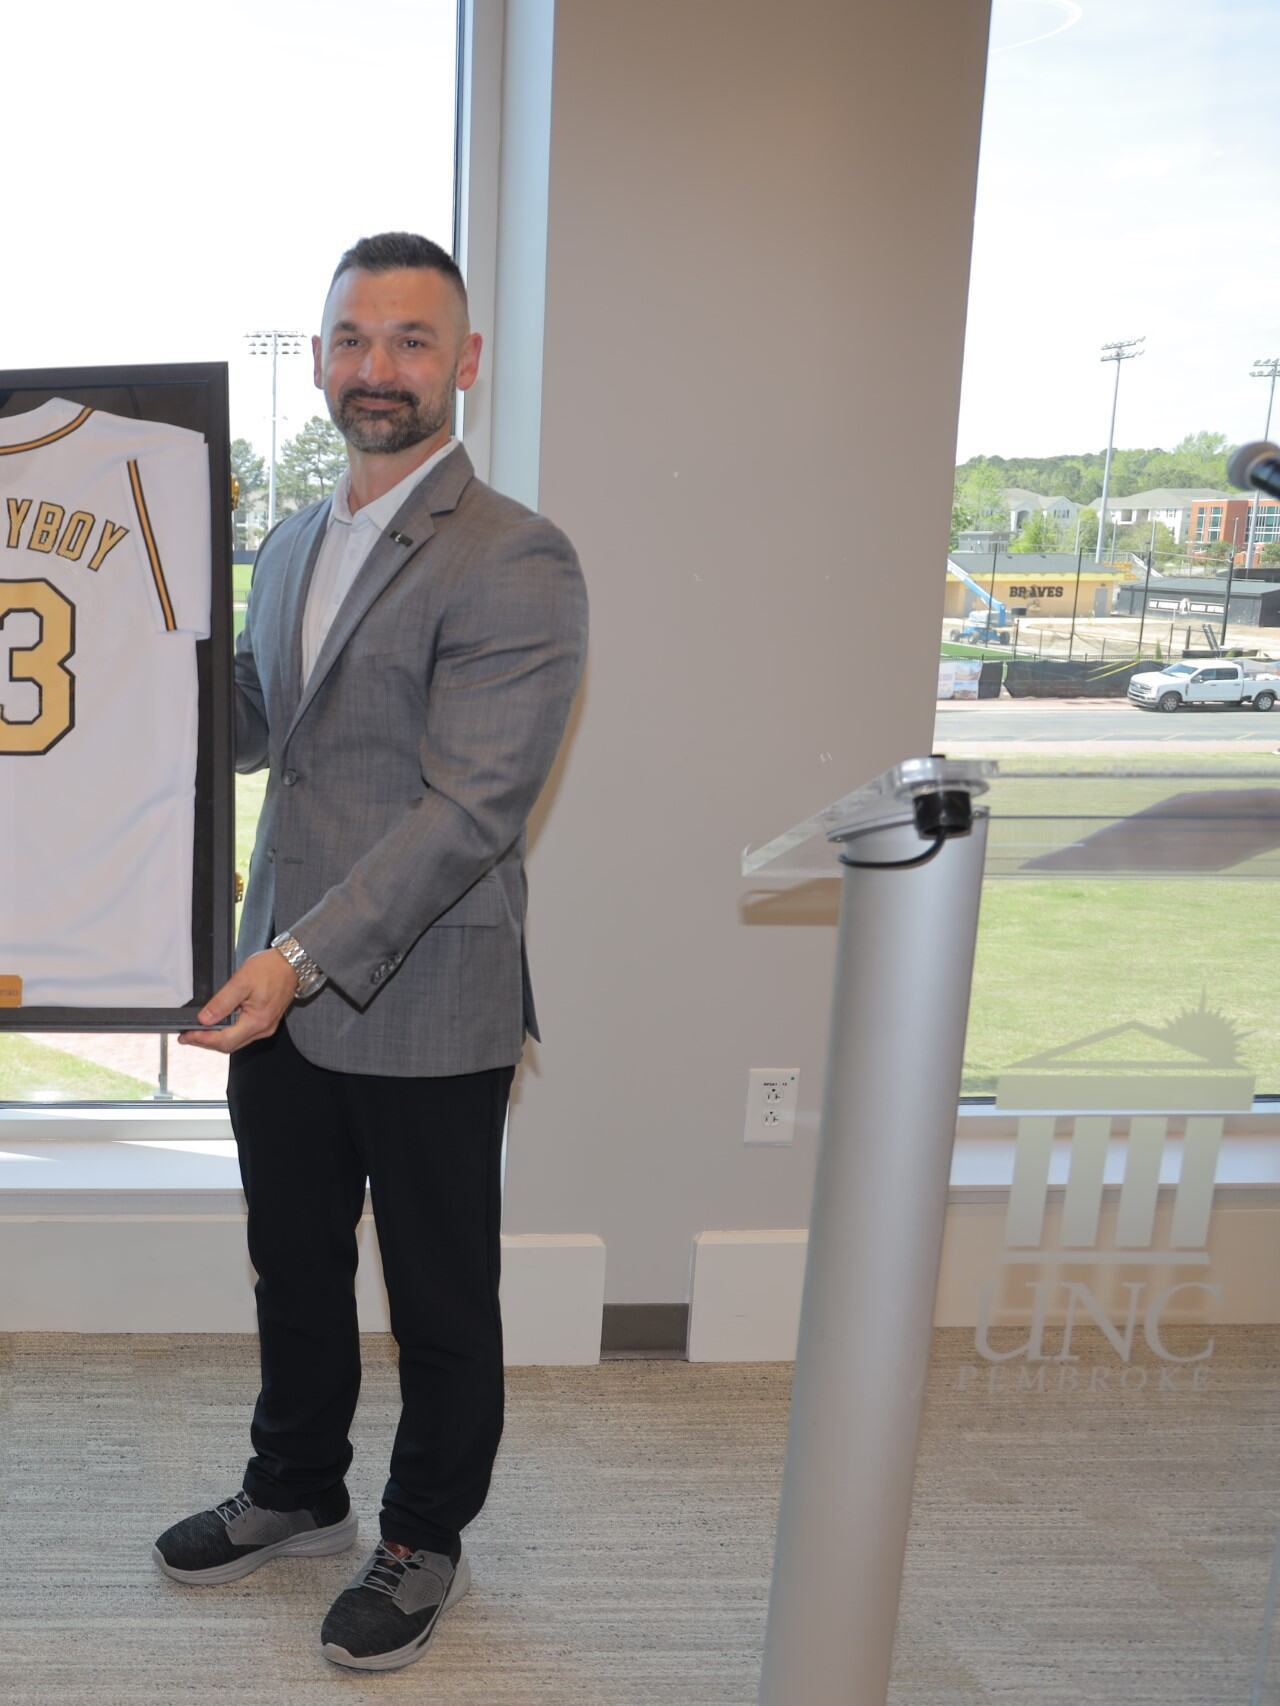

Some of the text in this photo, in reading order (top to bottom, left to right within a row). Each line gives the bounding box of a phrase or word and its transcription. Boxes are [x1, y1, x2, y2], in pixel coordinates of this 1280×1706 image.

[1009, 585, 1064, 599] BRAVES
[974, 1281, 1223, 1363] UNC
[953, 1365, 1212, 1392] PEMBROKE
